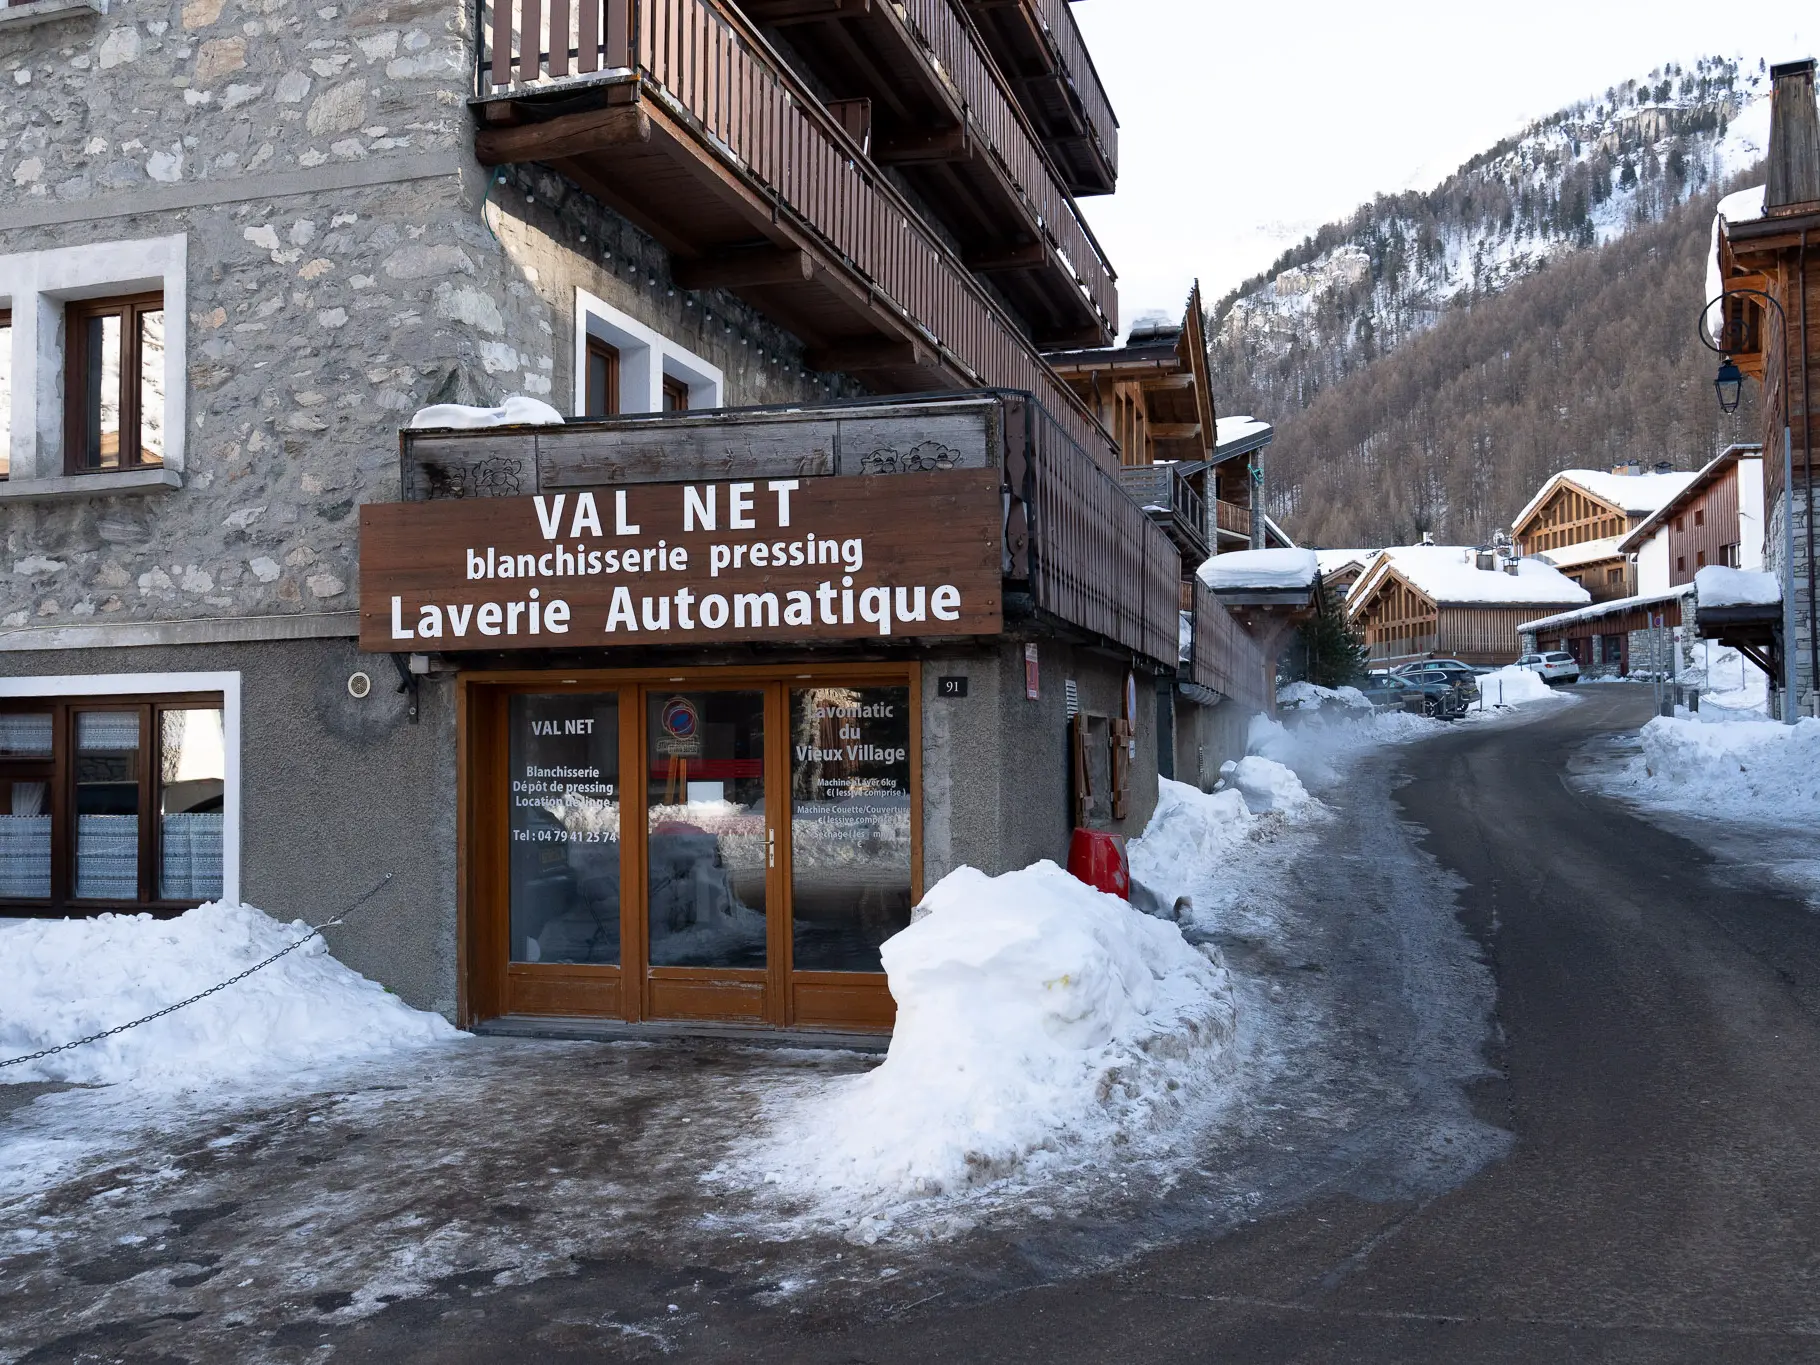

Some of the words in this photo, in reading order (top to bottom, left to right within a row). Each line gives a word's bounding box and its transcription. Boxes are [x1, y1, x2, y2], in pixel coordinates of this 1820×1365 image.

[533, 490, 639, 540] VAL
[683, 480, 798, 531] NET
[466, 539, 688, 580] blanchisserie
[710, 532, 863, 577] pressing
[391, 588, 571, 639] Laverie
[605, 576, 962, 635] Automatique
[946, 681, 958, 692] 91
[808, 701, 894, 719] Lavomatic
[532, 720, 561, 735] VAL
[565, 719, 594, 734] NET
[839, 723, 860, 739] du
[796, 745, 843, 761] Vieux
[846, 744, 905, 765] Village
[526, 766, 600, 778] Blanchisserie
[513, 780, 547, 794] Dépôt
[550, 781, 563, 792] de
[566, 781, 614, 795] pressing
[817, 778, 851, 787] Machine
[881, 778, 896, 788] 6kg
[864, 788, 901, 798] comprise
[515, 796, 562, 807] Location
[797, 805, 830, 814] Machine
[827, 815, 854, 824] lessive
[538, 830, 551, 841] 04
[554, 831, 567, 842] 79
[570, 831, 583, 842] 41
[586, 832, 600, 843] 25
[603, 832, 617, 843] 74
